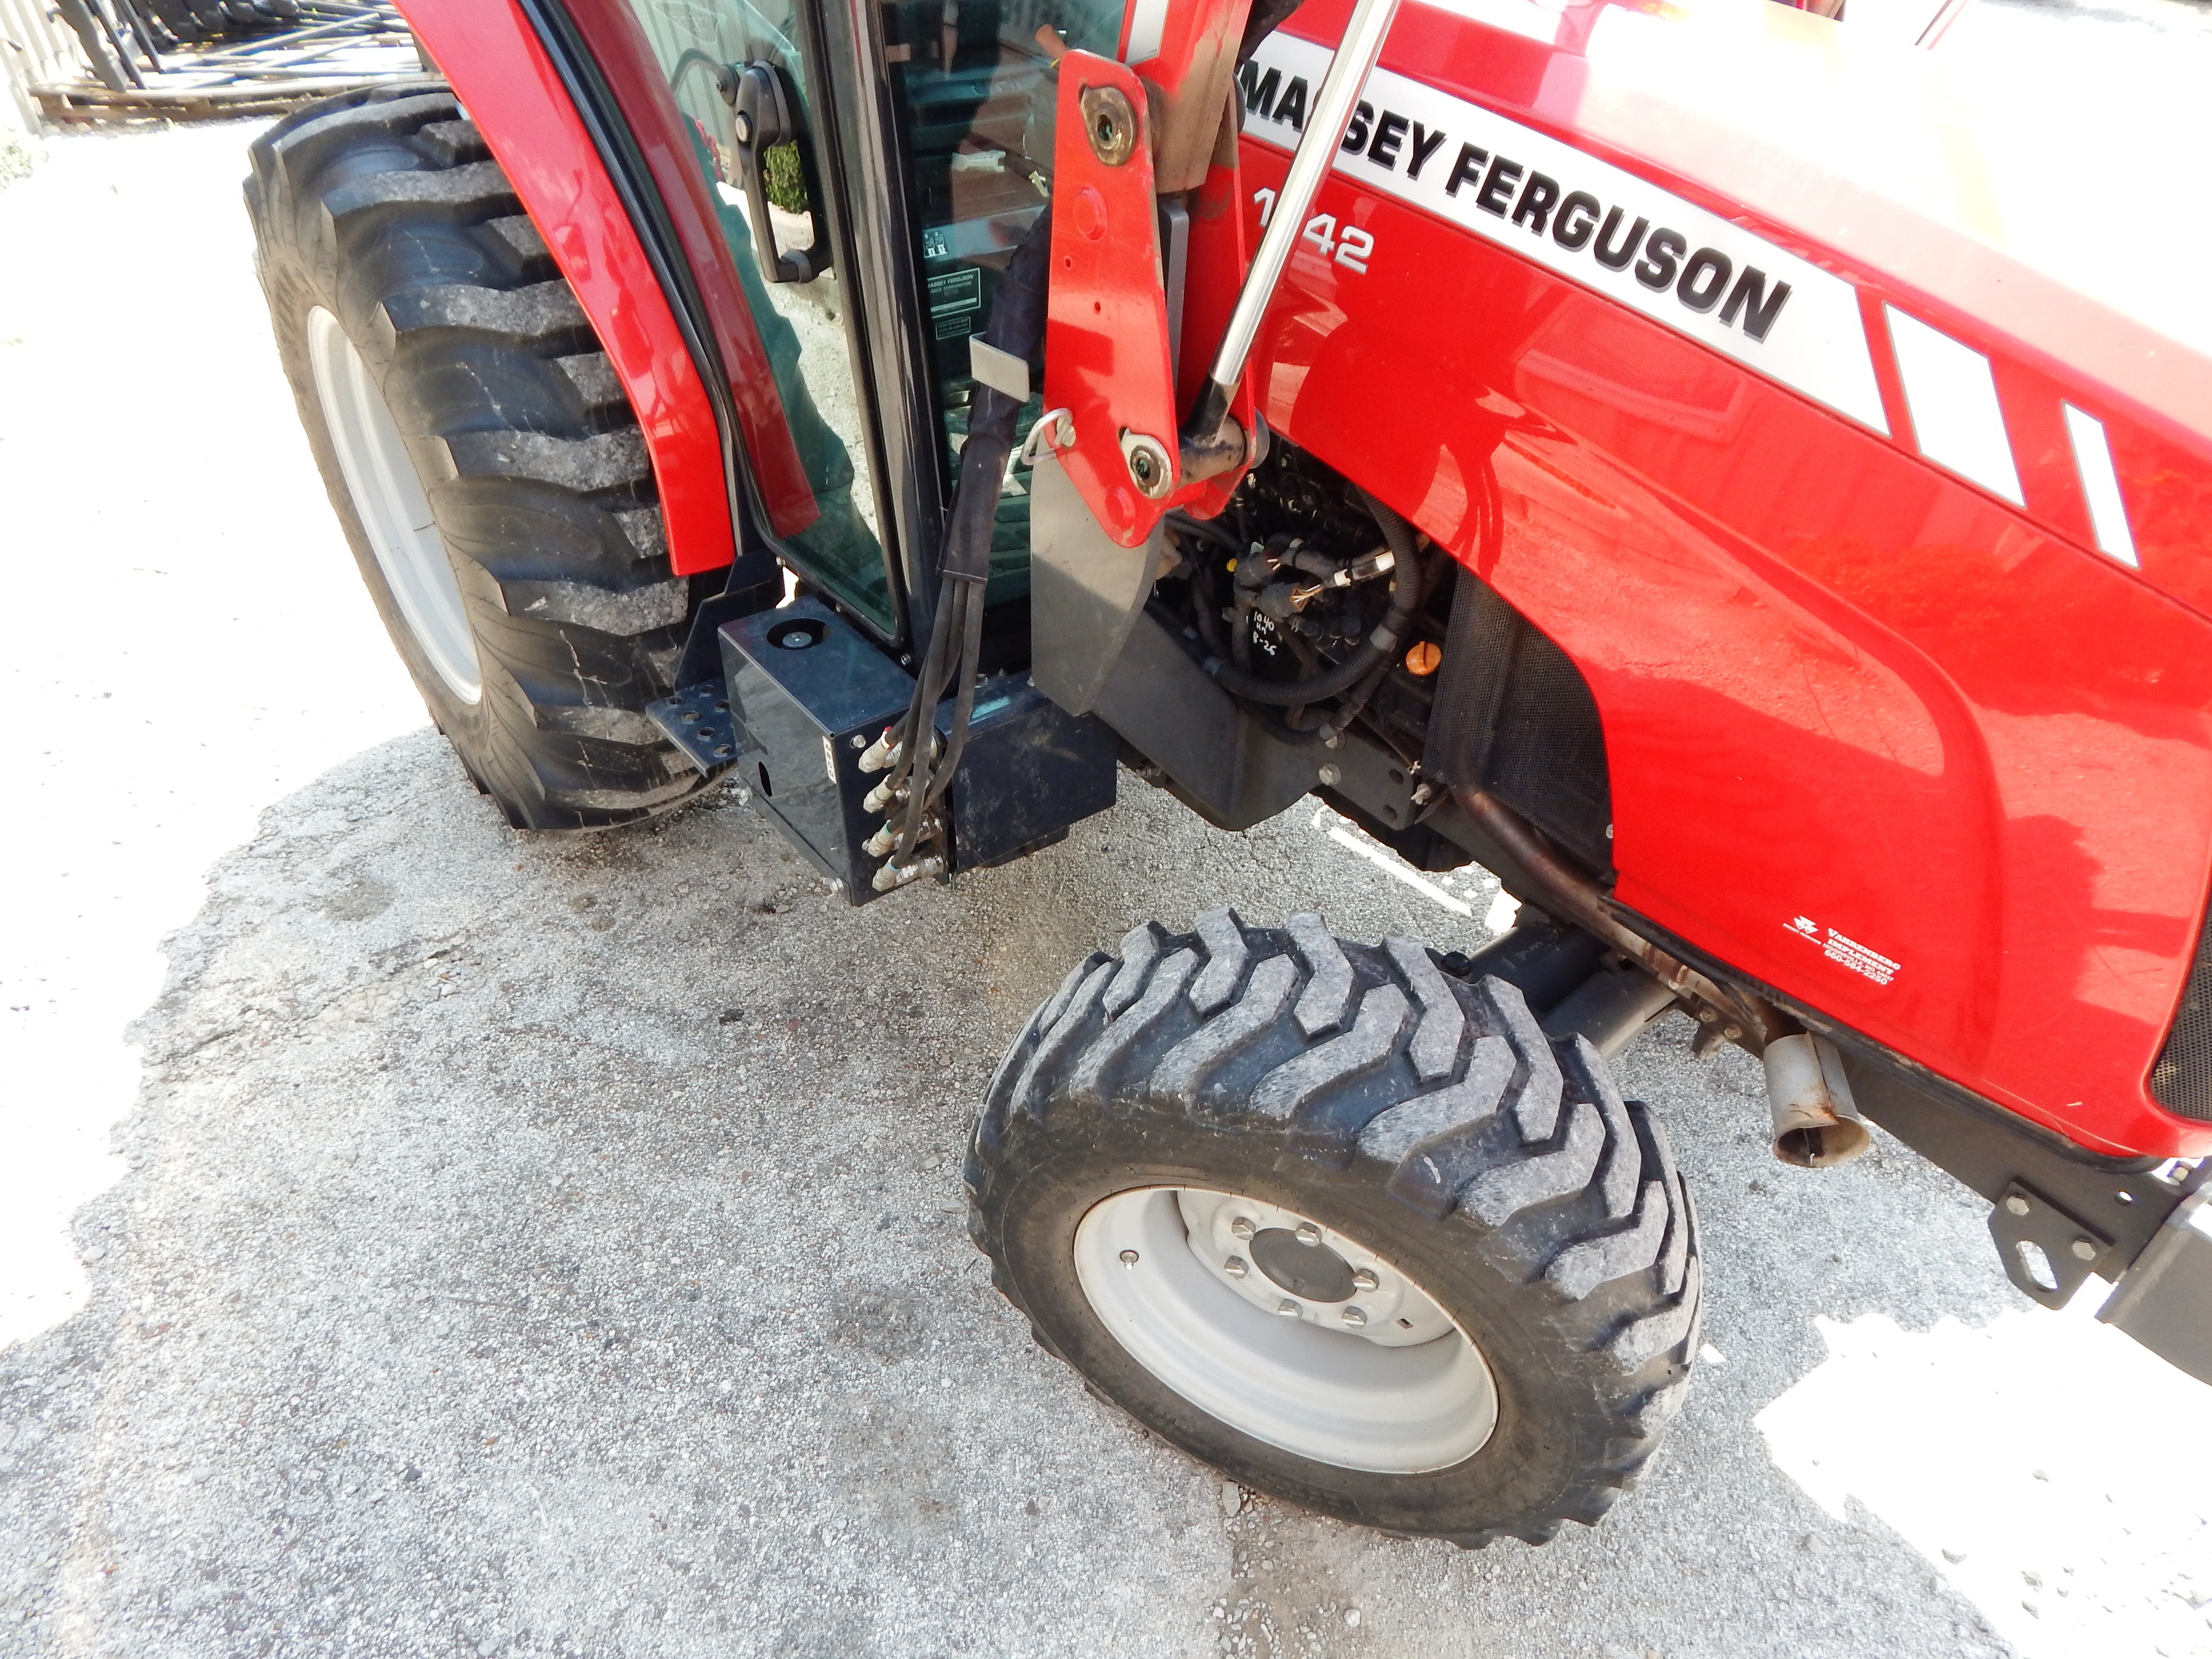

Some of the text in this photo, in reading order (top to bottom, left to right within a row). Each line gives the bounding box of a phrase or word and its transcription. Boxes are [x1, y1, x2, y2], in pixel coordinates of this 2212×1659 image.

[1240, 59, 1793, 344] MASEY FERGUSON
[1253, 185, 1374, 275] 142
[1254, 611, 1274, 631] 1040
[1824, 949, 1888, 985] 660-584-2250
[1827, 938, 1894, 975] IMPLEMENT
[1828, 927, 1901, 970] VAHRENBERG
